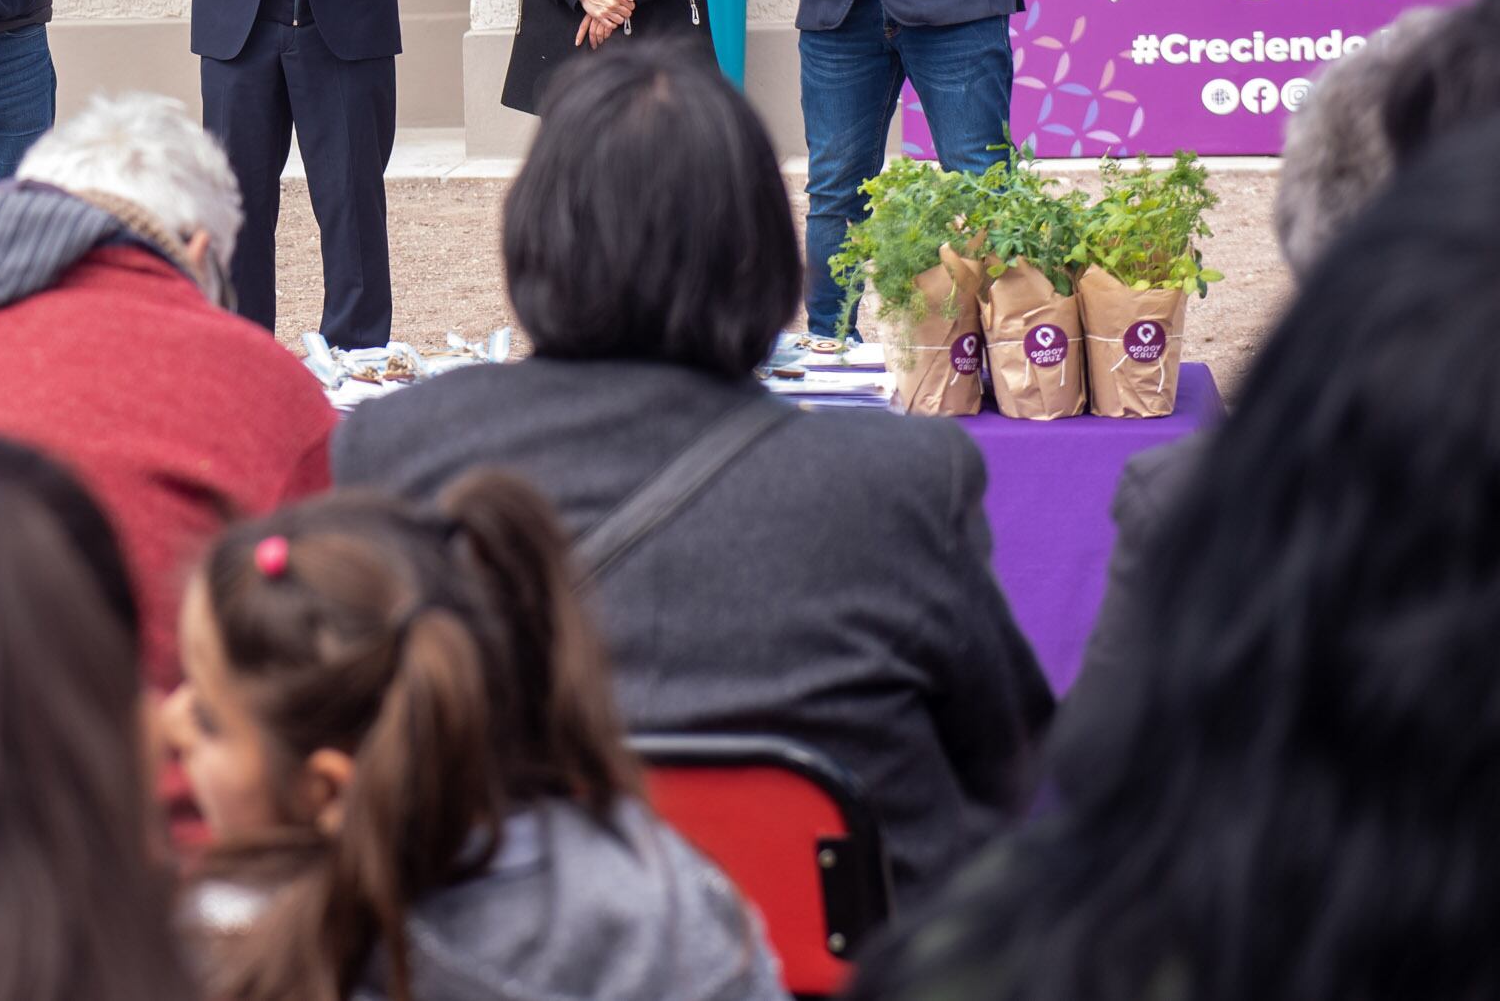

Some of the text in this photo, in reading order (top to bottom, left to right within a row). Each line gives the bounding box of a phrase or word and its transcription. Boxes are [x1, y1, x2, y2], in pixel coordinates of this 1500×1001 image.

[1030, 347, 1064, 358] GODOY
[1129, 344, 1163, 352] GODOY
[1035, 354, 1061, 364] CRUZ
[1133, 351, 1159, 359] CRUZ
